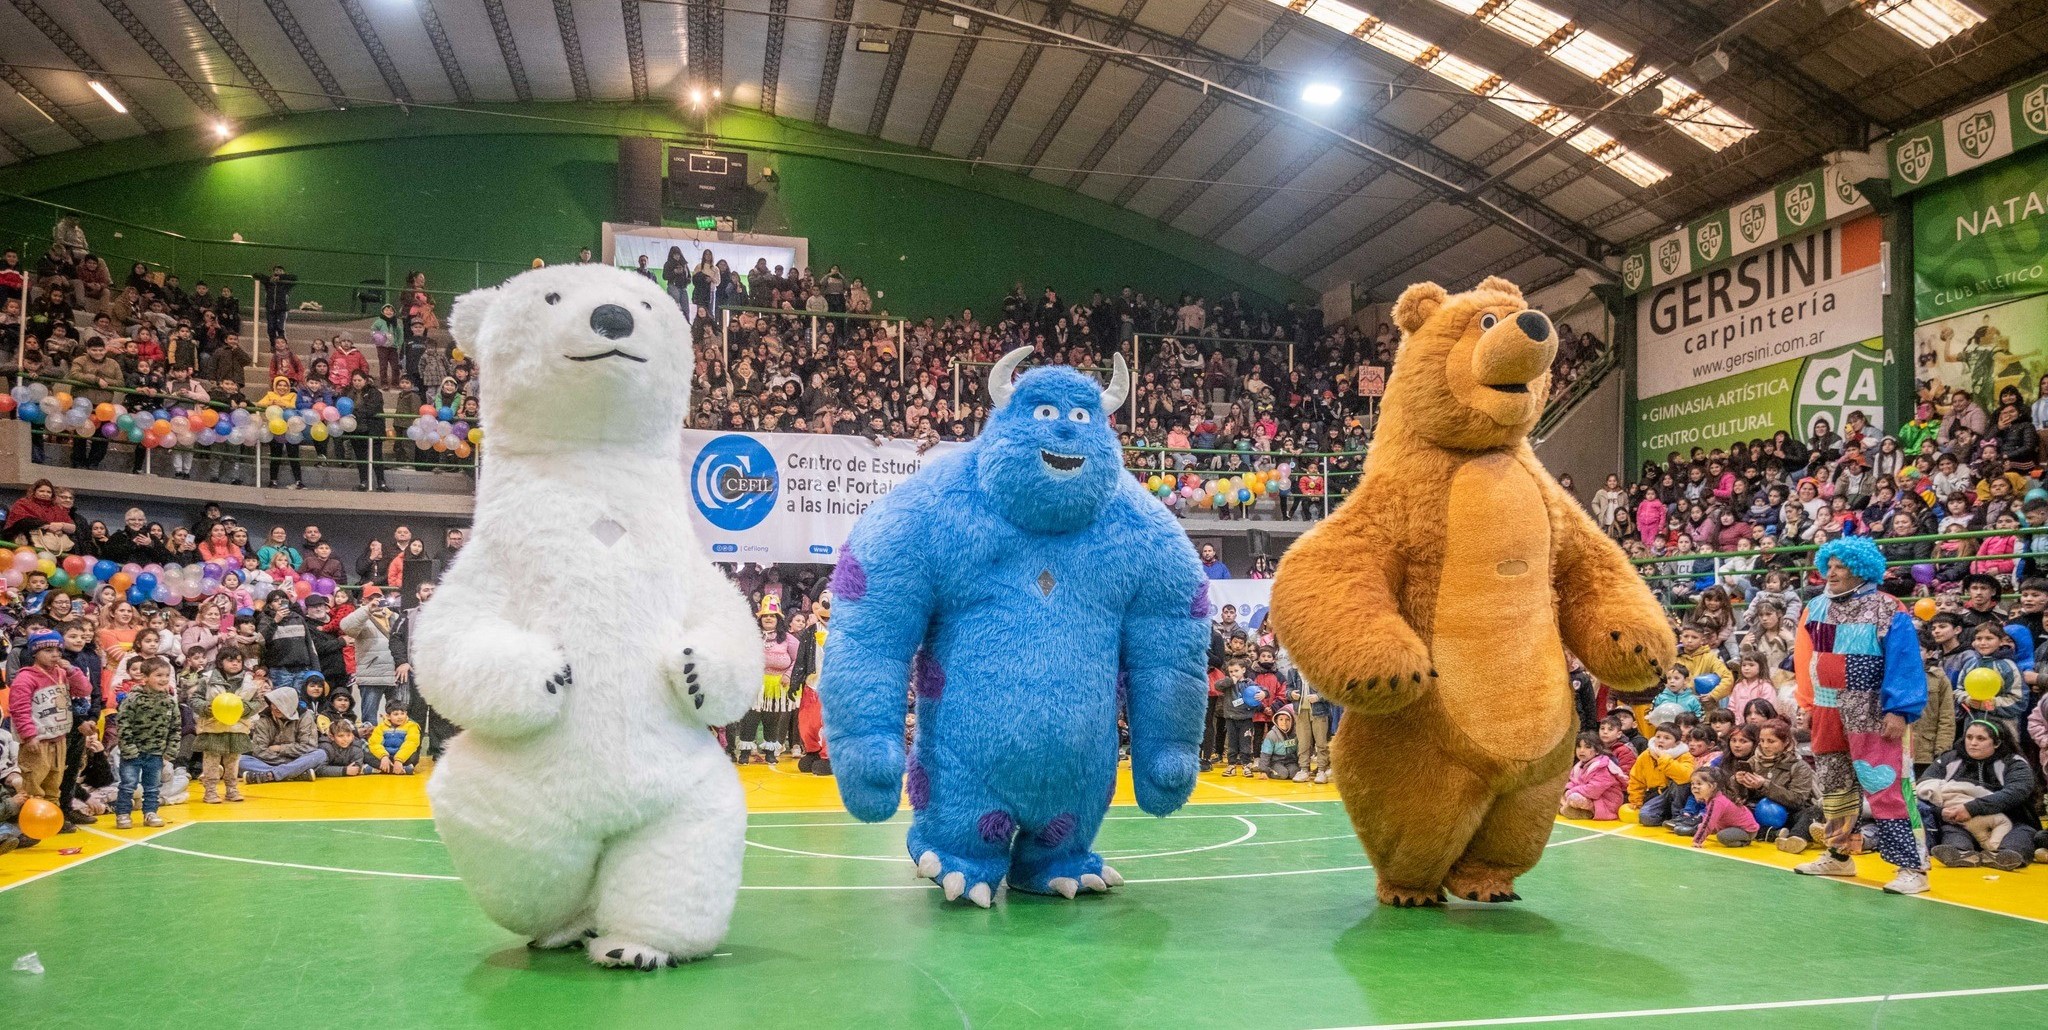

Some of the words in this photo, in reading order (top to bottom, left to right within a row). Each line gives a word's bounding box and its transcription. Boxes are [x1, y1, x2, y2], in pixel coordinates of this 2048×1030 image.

[1956, 191, 2048, 241] NATA
[1650, 228, 1832, 336] GERSINI
[1935, 286, 1973, 306] CLUB
[1684, 291, 1836, 354] carpintería
[1693, 329, 1825, 379] www.gersini.com.ar
[1650, 396, 1715, 423] GIMNASIA
[1716, 377, 1789, 409] ARTÍSTICA
[1650, 427, 1699, 450] CENTRO
[1702, 412, 1775, 440] CULTURAL
[787, 453, 842, 471] Centro
[847, 456, 867, 473] de
[872, 458, 921, 475] Estudi
[726, 478, 773, 492] CEFIL
[787, 477, 822, 495] para
[827, 476, 841, 493] el
[846, 477, 895, 495] Fortal
[787, 499, 796, 513] a
[801, 496, 822, 513] las
[827, 498, 873, 516] Inicia
